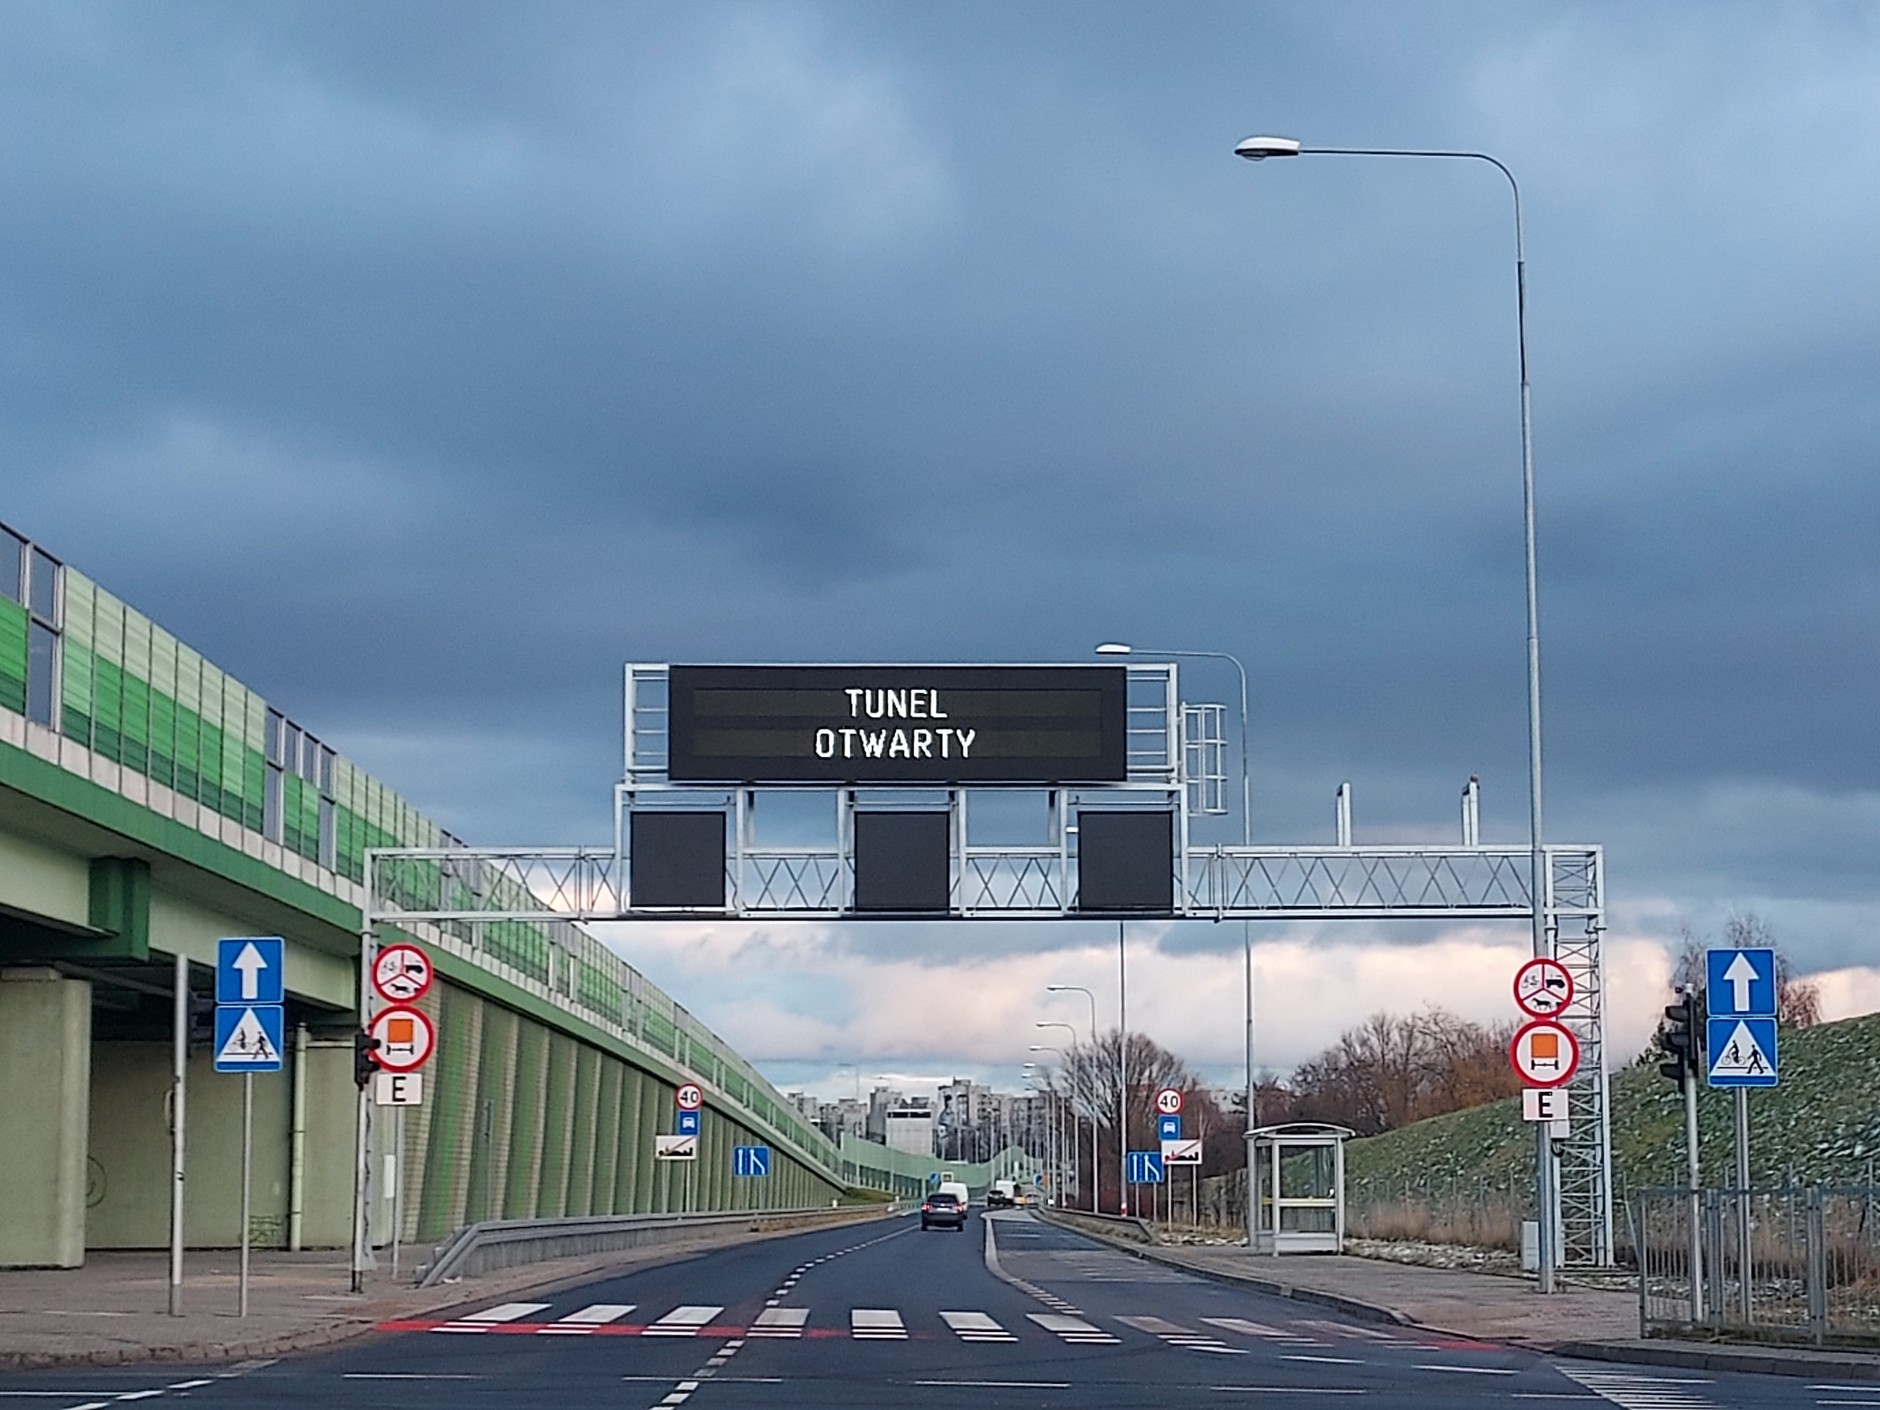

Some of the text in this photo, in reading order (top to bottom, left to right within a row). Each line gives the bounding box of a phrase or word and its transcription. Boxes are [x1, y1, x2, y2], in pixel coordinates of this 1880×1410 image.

[845, 688, 948, 719] TUNEL
[815, 728, 976, 759] OTWARTY
[391, 1076, 407, 1102] E
[680, 1090, 699, 1104] 40
[1159, 1095, 1179, 1109] 40
[1538, 1091, 1554, 1118] E
